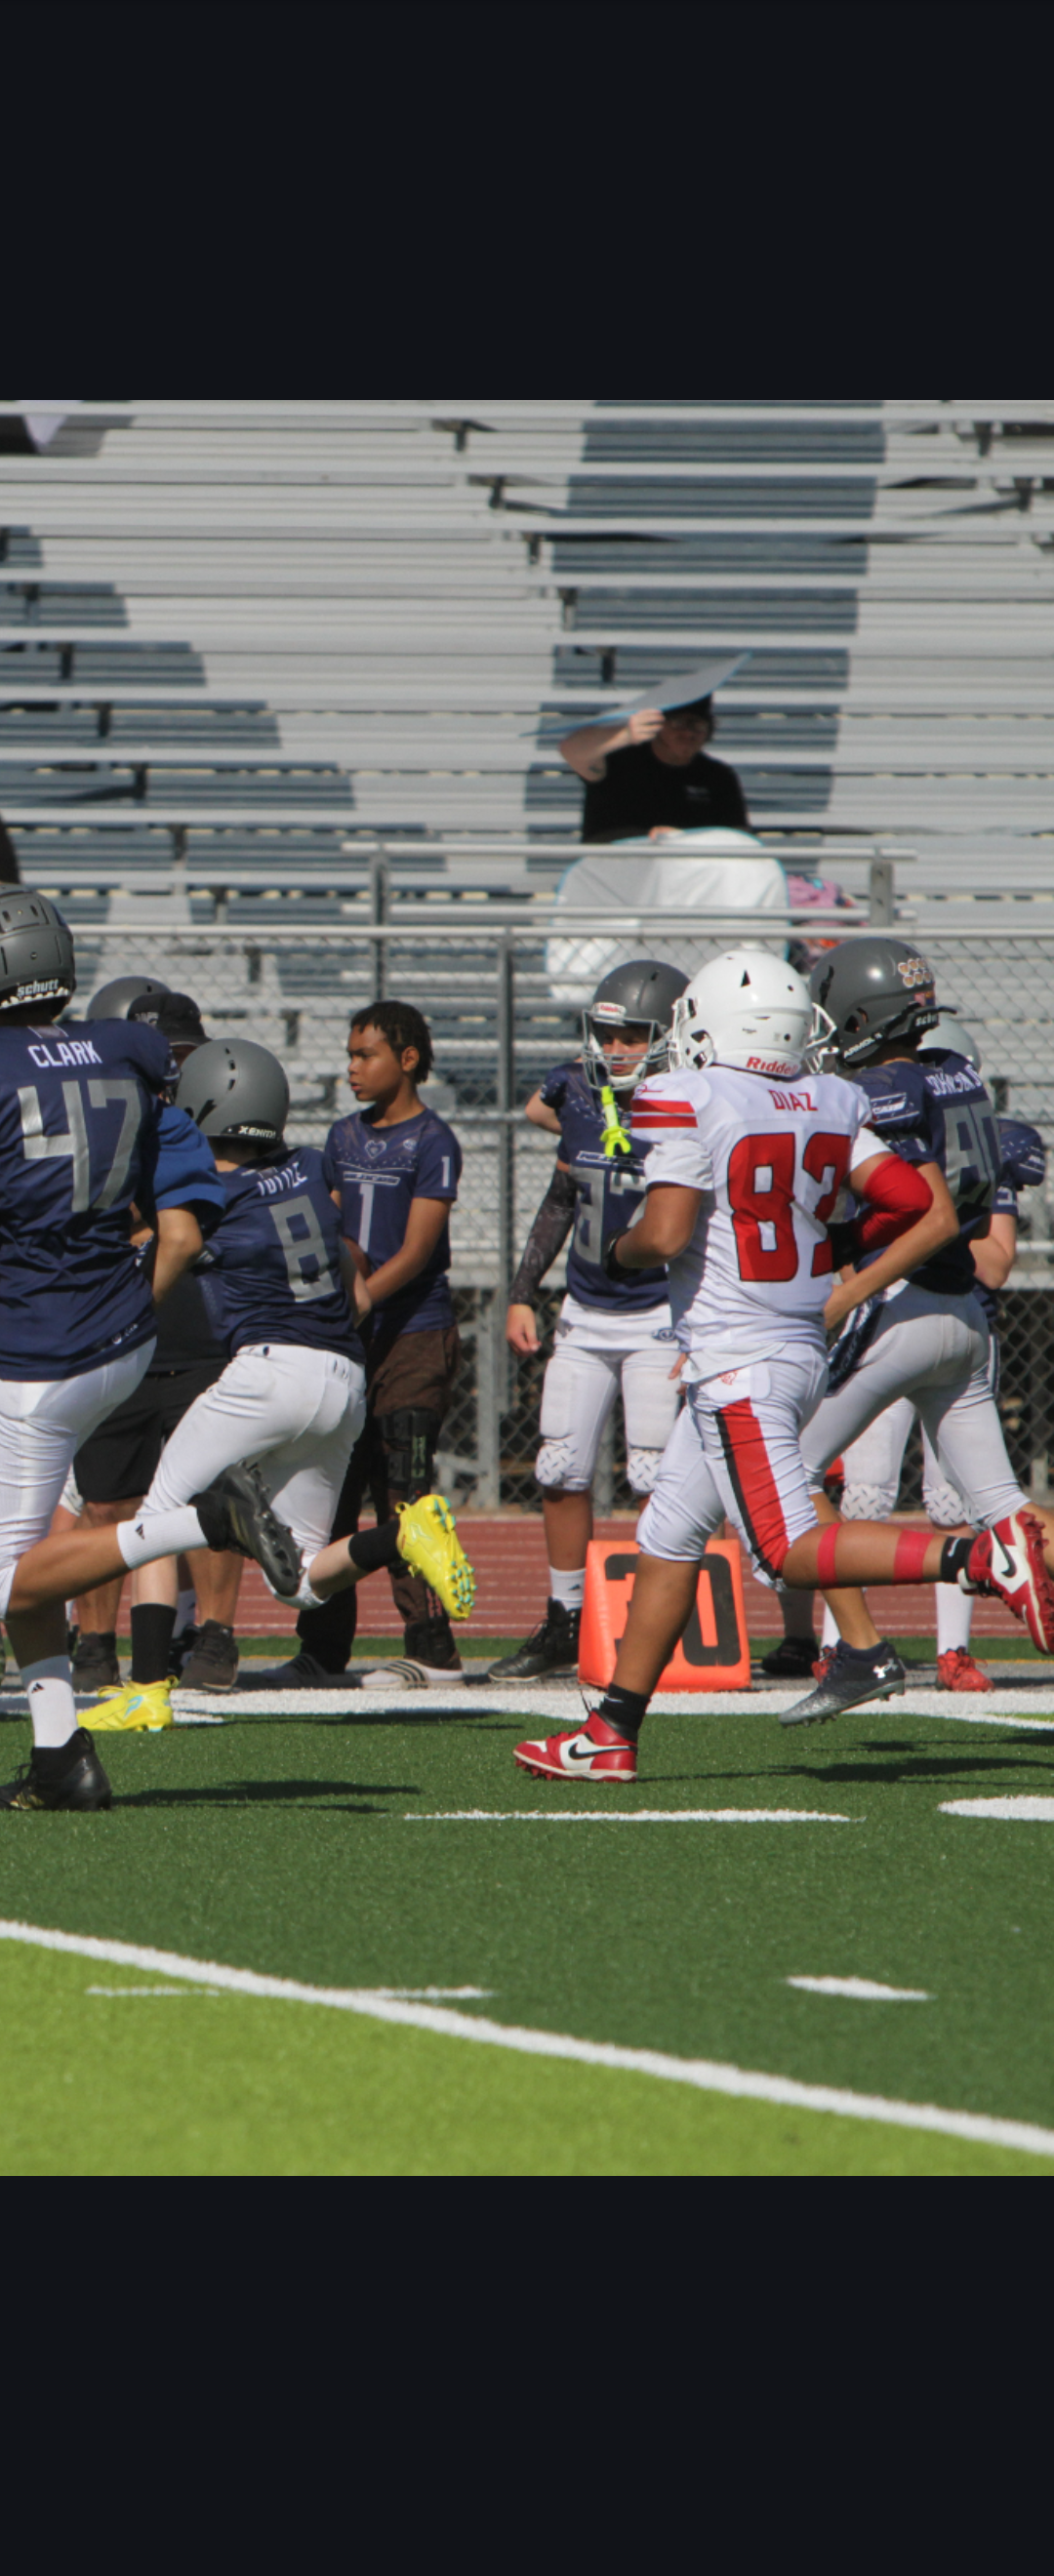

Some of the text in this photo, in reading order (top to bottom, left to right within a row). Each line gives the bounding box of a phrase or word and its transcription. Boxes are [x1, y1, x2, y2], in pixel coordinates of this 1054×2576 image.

[17, 979, 59, 997] schutt
[27, 1040, 102, 1068] CLARK
[767, 1088, 819, 1111] DIAZ
[17, 1079, 142, 1213] 47
[942, 1099, 1000, 1209] 80
[441, 1156, 450, 1188] 1
[358, 1183, 375, 1253] 1
[268, 1193, 337, 1303] 8
